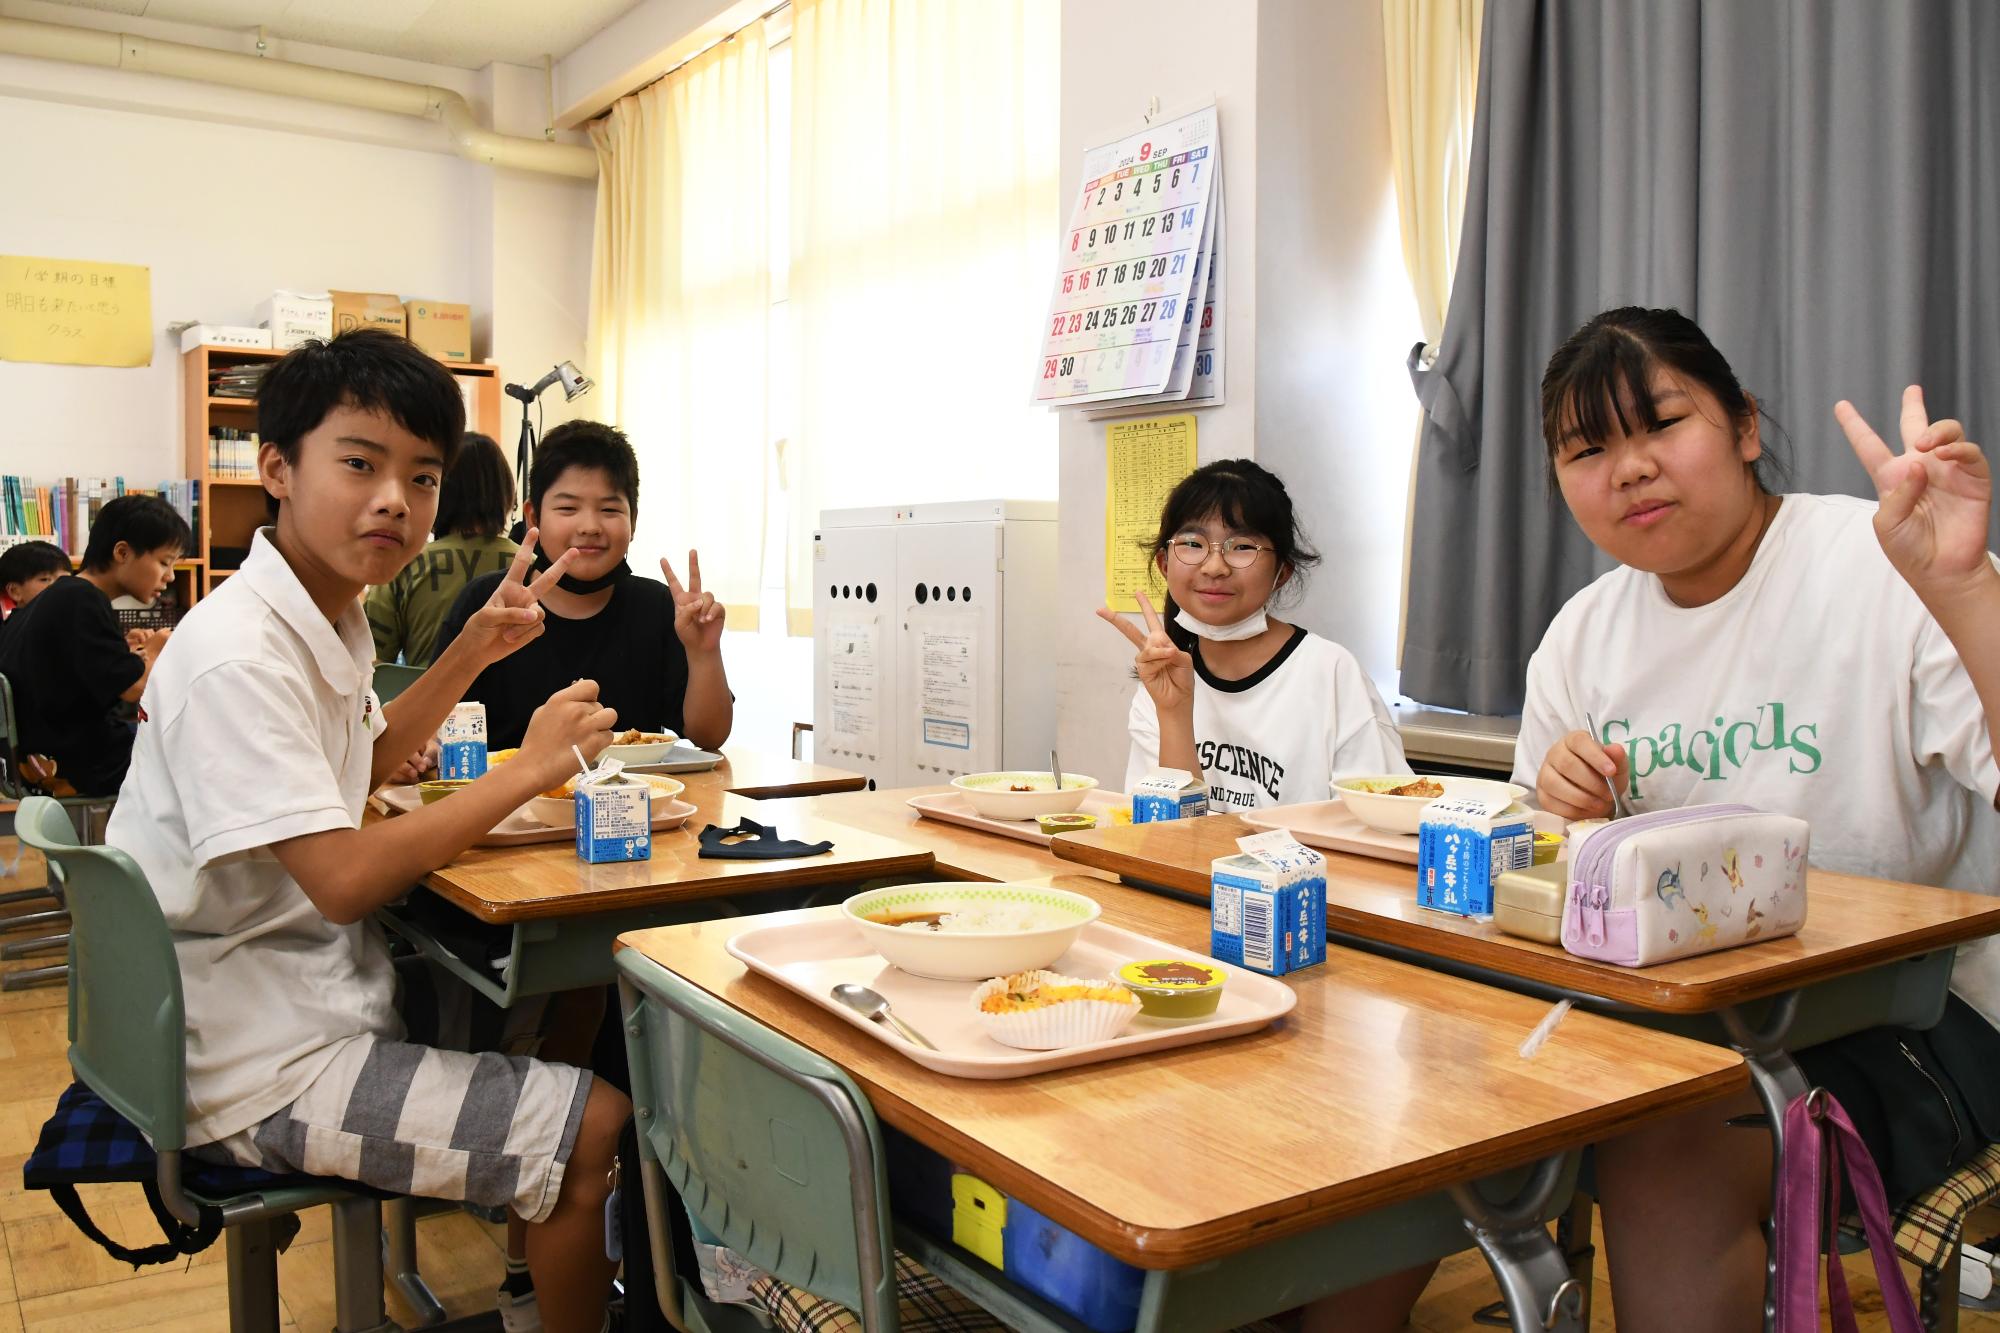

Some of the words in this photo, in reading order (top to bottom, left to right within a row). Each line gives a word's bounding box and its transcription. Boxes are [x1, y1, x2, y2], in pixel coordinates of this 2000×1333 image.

[1116, 168, 1130, 179] TUE
[1153, 160, 1168, 171] THU
[1172, 154, 1186, 166] FRI
[1190, 148, 1206, 160] SAT
[1139, 142, 1152, 162] 9
[1152, 147, 1168, 159] SEP
[1084, 194, 1092, 211] 1
[1097, 187, 1107, 206] 2
[1114, 182, 1124, 202] 3
[1133, 178, 1143, 197] 4
[1152, 173, 1162, 194] 5
[1171, 168, 1181, 188] 6
[1191, 163, 1200, 184] 7
[1071, 233, 1080, 252] 8
[1088, 229, 1097, 248] 9
[1104, 224, 1118, 245] 10
[1123, 220, 1136, 241] 11
[1141, 216, 1156, 237] 12
[1161, 212, 1175, 234] 13
[1180, 207, 1195, 229] 14
[1062, 274, 1075, 294] 15
[1078, 270, 1091, 291] 16
[1096, 267, 1108, 287] 17
[1113, 264, 1128, 284] 18
[1132, 260, 1147, 281] 19
[1149, 257, 1167, 278] 20
[1170, 253, 1186, 275] 21
[1051, 316, 1066, 337] 22
[1067, 313, 1082, 334] 23
[1084, 310, 1100, 331] 24
[1102, 307, 1118, 328] 25
[1120, 304, 1138, 326] 26
[1140, 302, 1157, 323] 27
[1159, 298, 1177, 321] 28
[1043, 358, 1058, 379] 29
[1059, 355, 1075, 377] 30
[1096, 351, 1106, 372] 2
[1114, 348, 1125, 370] 3
[1196, 353, 1212, 376] 30
[1226, 789, 1255, 808] TRUE
